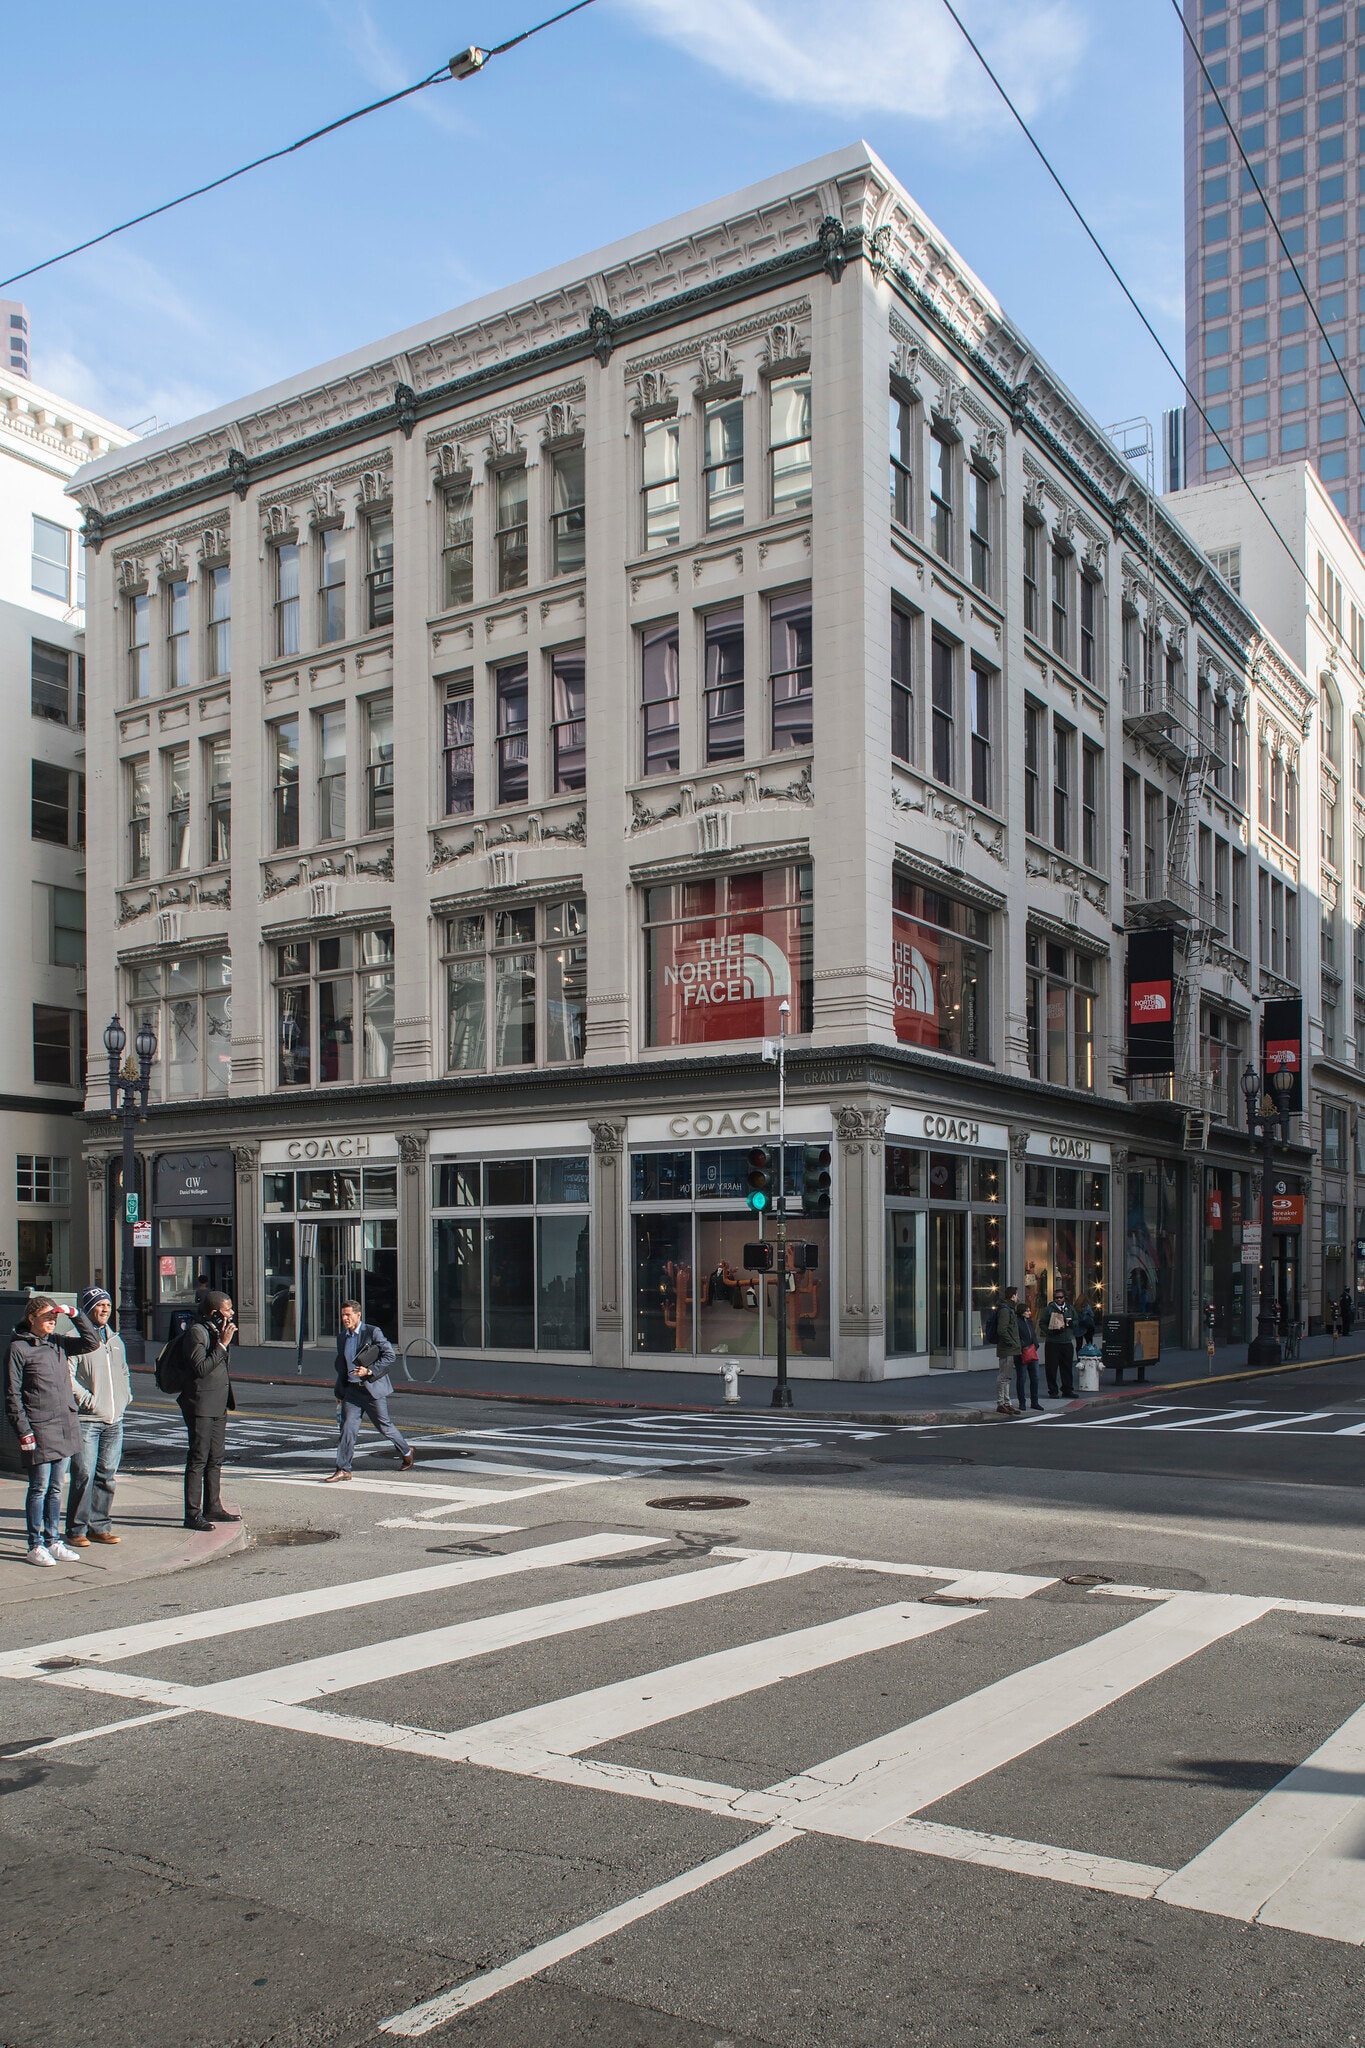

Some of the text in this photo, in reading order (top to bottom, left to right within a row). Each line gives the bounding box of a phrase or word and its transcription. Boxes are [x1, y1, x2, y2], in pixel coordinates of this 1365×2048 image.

[696, 934, 741, 959] THE
[894, 940, 911, 965] HE
[664, 958, 741, 986] NORTH
[683, 979, 741, 1006] FACE
[894, 983, 911, 1009] CE
[804, 1069, 842, 1084] GRANT
[669, 1110, 780, 1138] COACH
[922, 1114, 979, 1144] COACH
[288, 1136, 370, 1160] COACH
[1049, 1136, 1092, 1160] COACH
